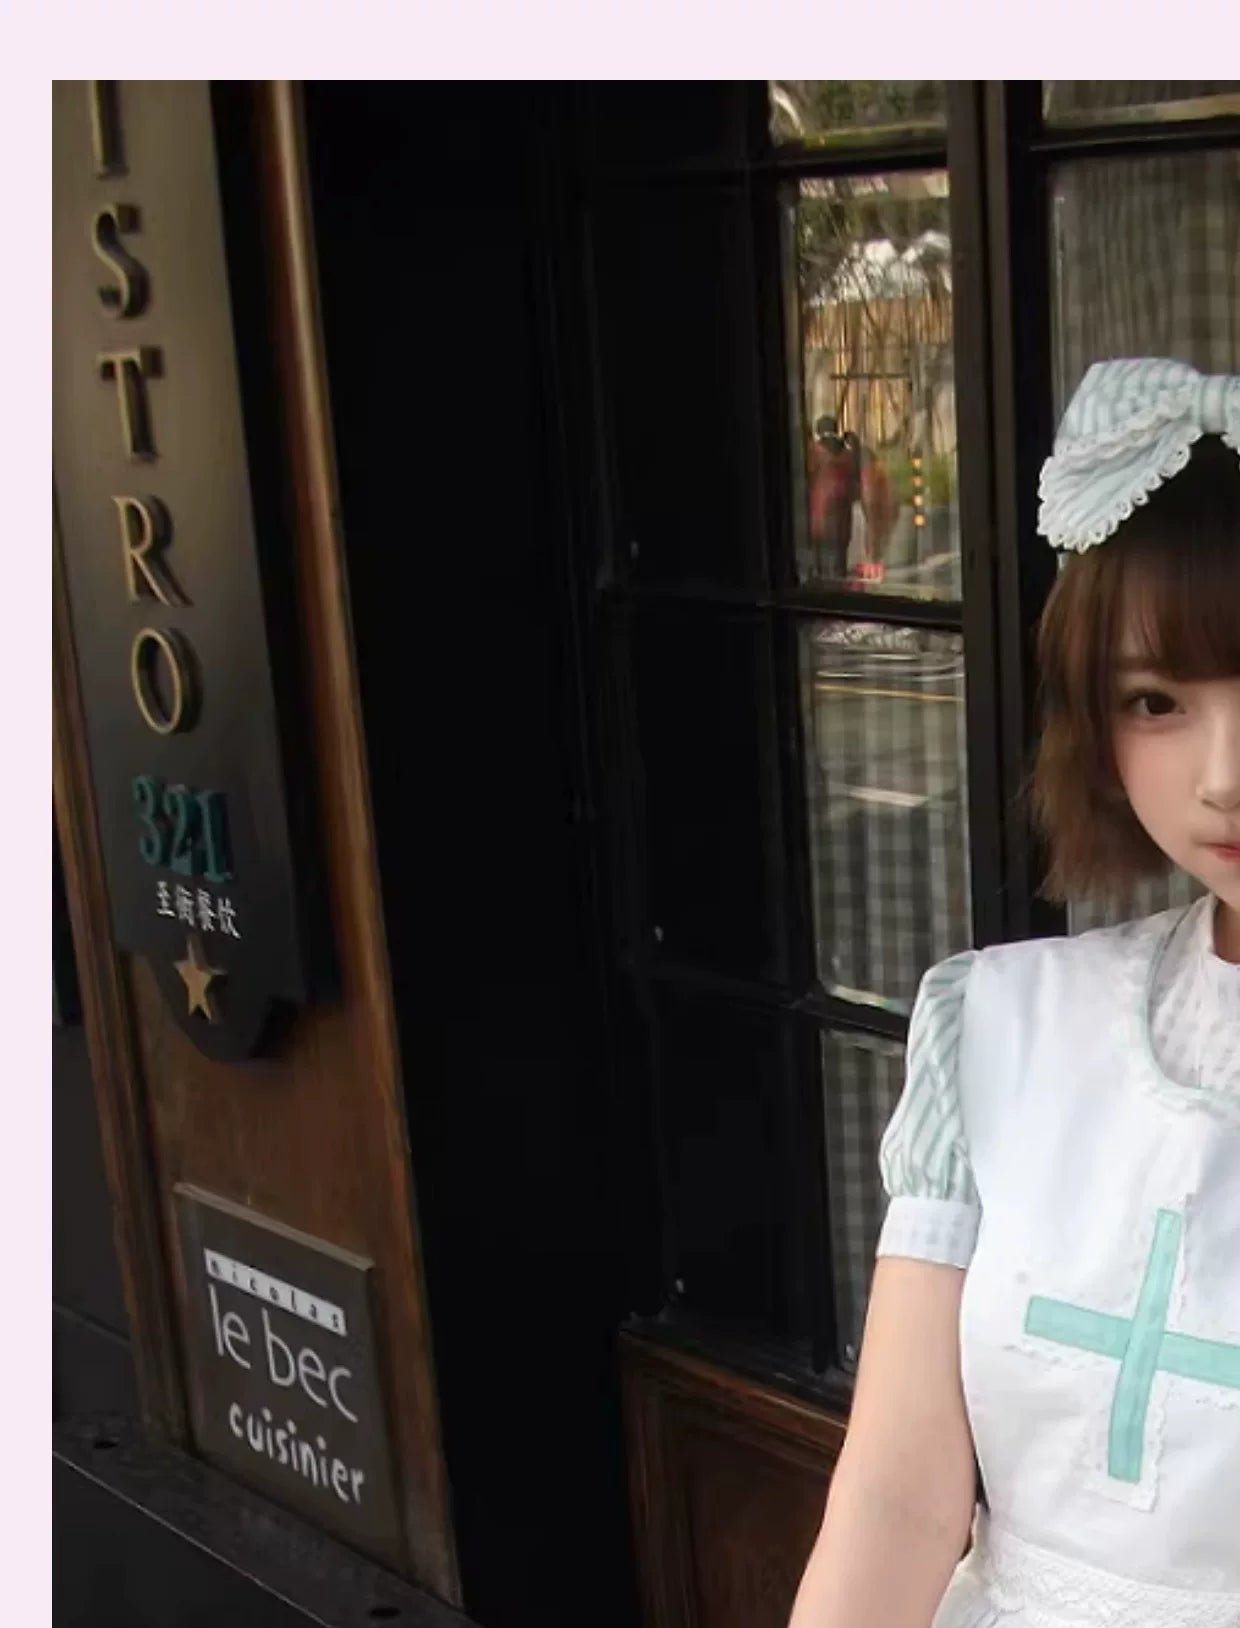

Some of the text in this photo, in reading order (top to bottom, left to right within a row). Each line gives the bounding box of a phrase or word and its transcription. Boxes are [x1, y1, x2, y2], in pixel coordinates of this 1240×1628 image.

[133, 775, 229, 882] 321
[209, 1257, 341, 1330] nicolas
[208, 1282, 359, 1423] le bec
[229, 1401, 364, 1503] cuisinier
